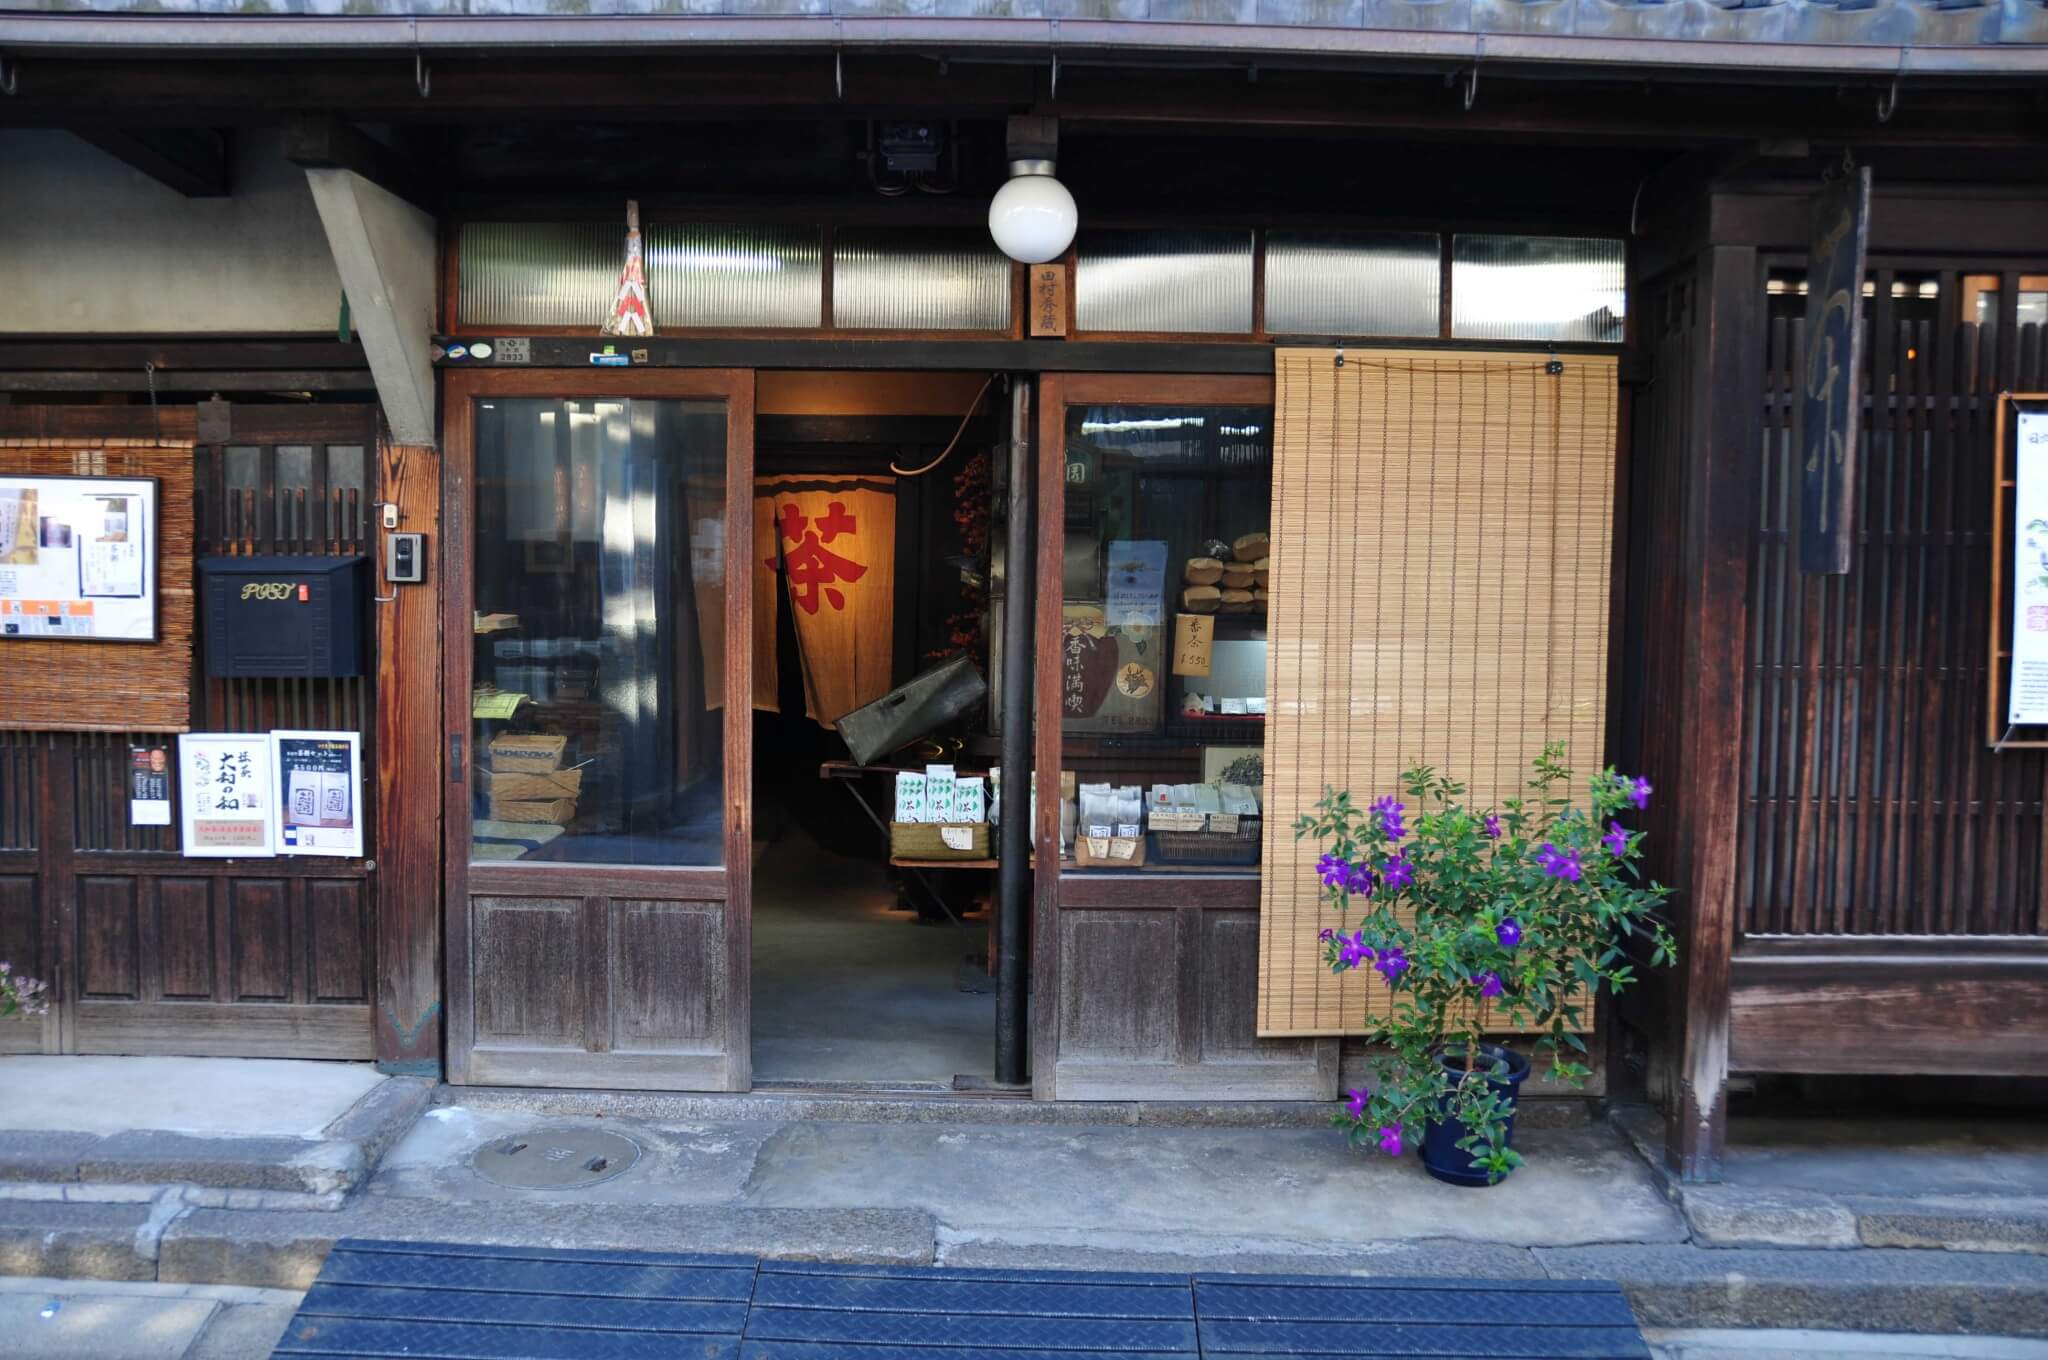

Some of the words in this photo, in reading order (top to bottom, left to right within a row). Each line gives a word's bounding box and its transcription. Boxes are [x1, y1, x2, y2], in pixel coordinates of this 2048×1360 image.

[241, 583, 297, 600] POST
[764, 501, 869, 616] 茶
[1064, 636, 1087, 713] 香味満喫
[215, 752, 240, 810] 大和の和
